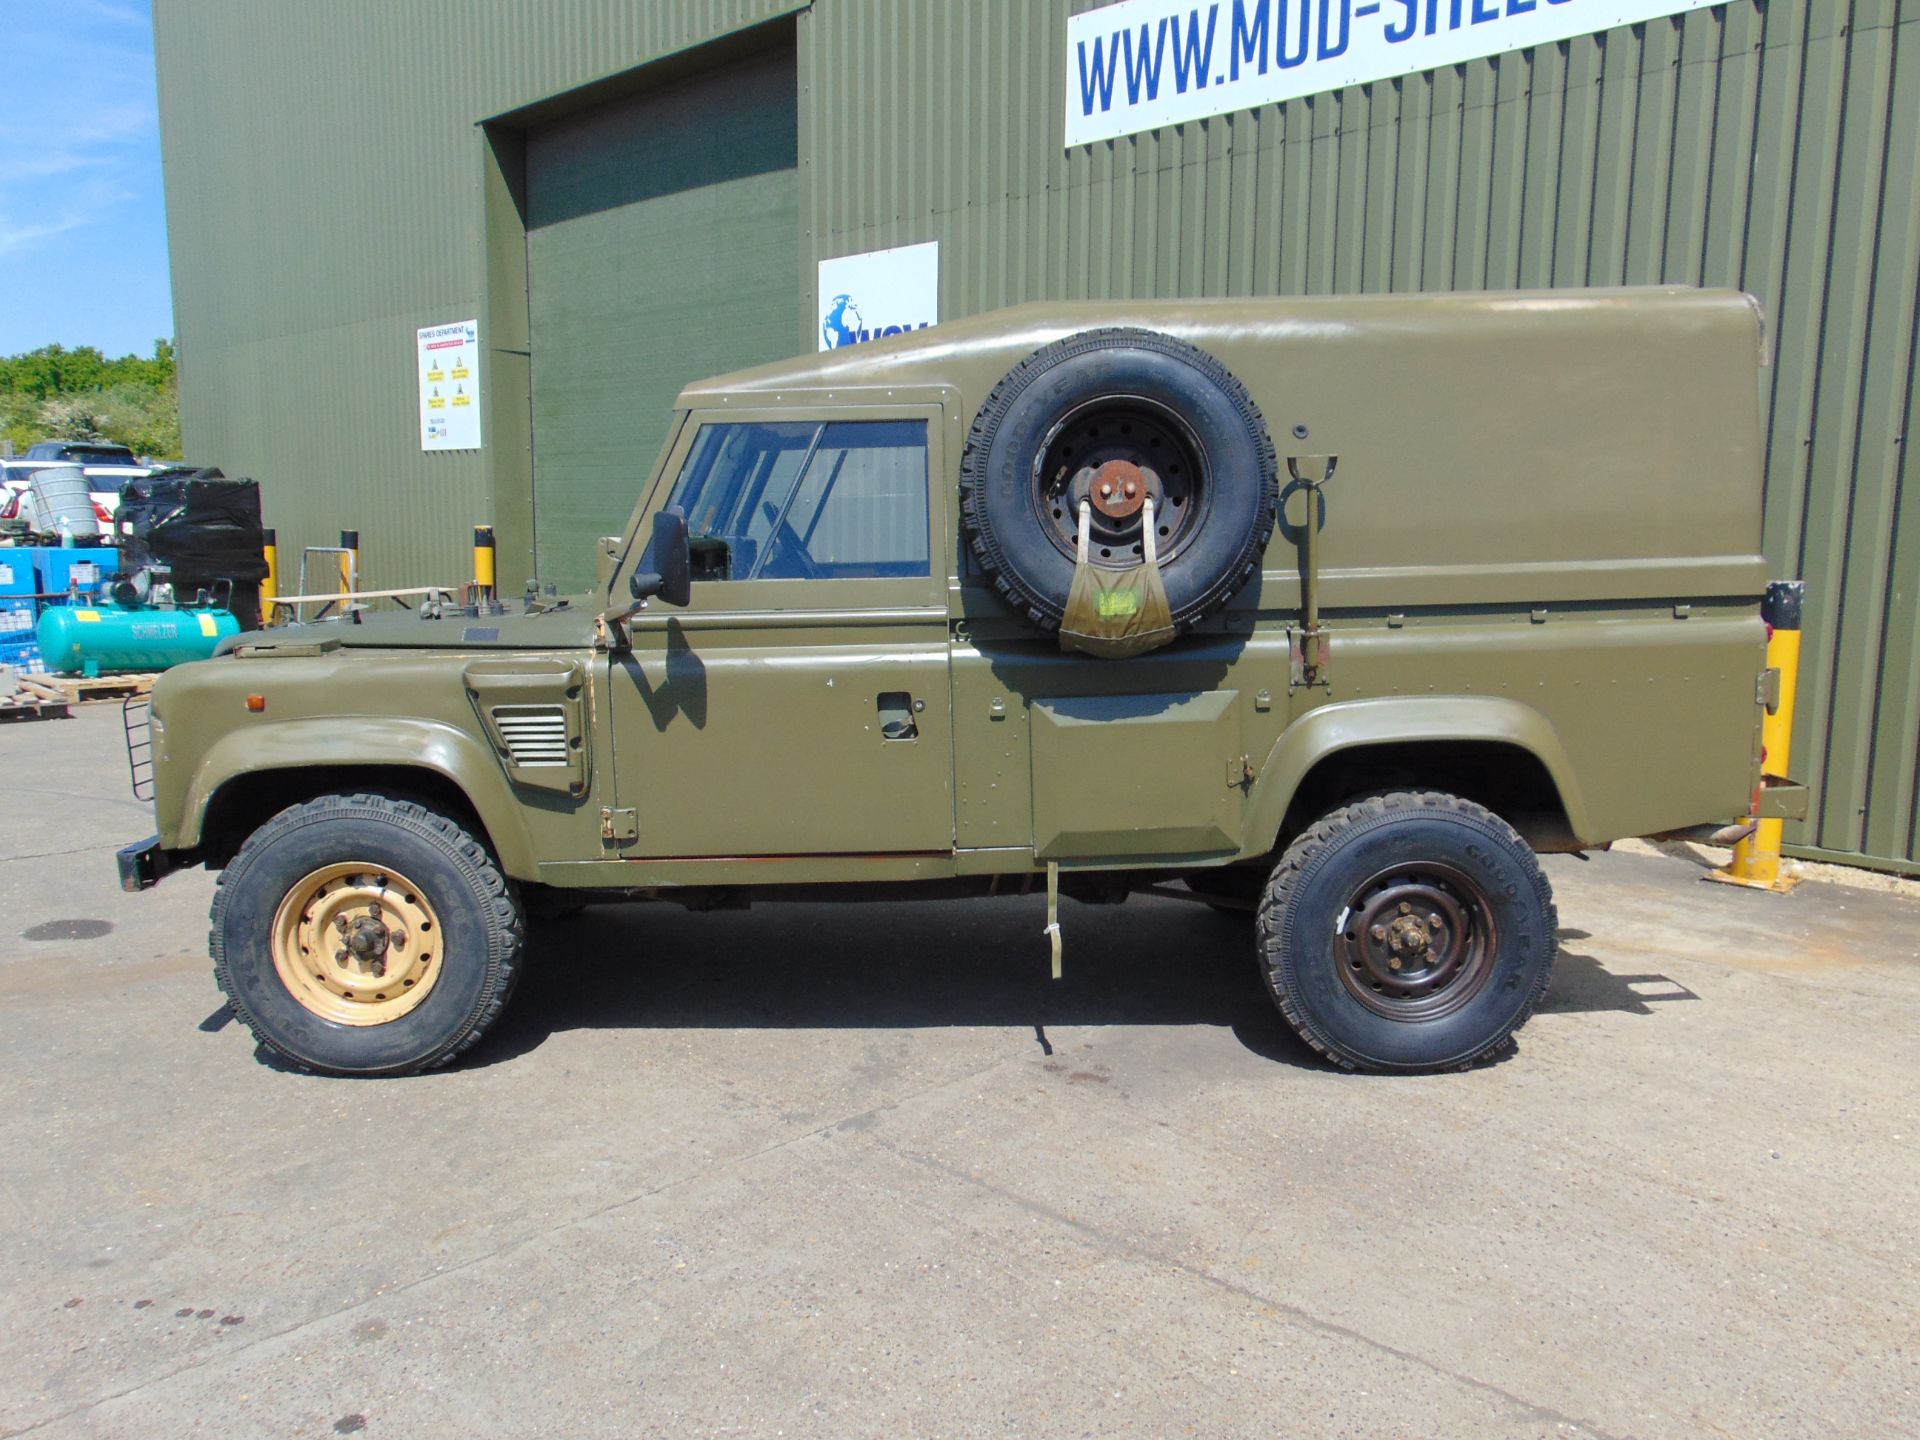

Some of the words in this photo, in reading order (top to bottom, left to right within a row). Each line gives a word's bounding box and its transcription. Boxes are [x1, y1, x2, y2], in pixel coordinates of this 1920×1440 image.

[1077, 0, 1573, 116] WWW.MOD-
[436, 326, 464, 337] DEPARTMENT
[1465, 843, 1531, 990] GOODYEAR
